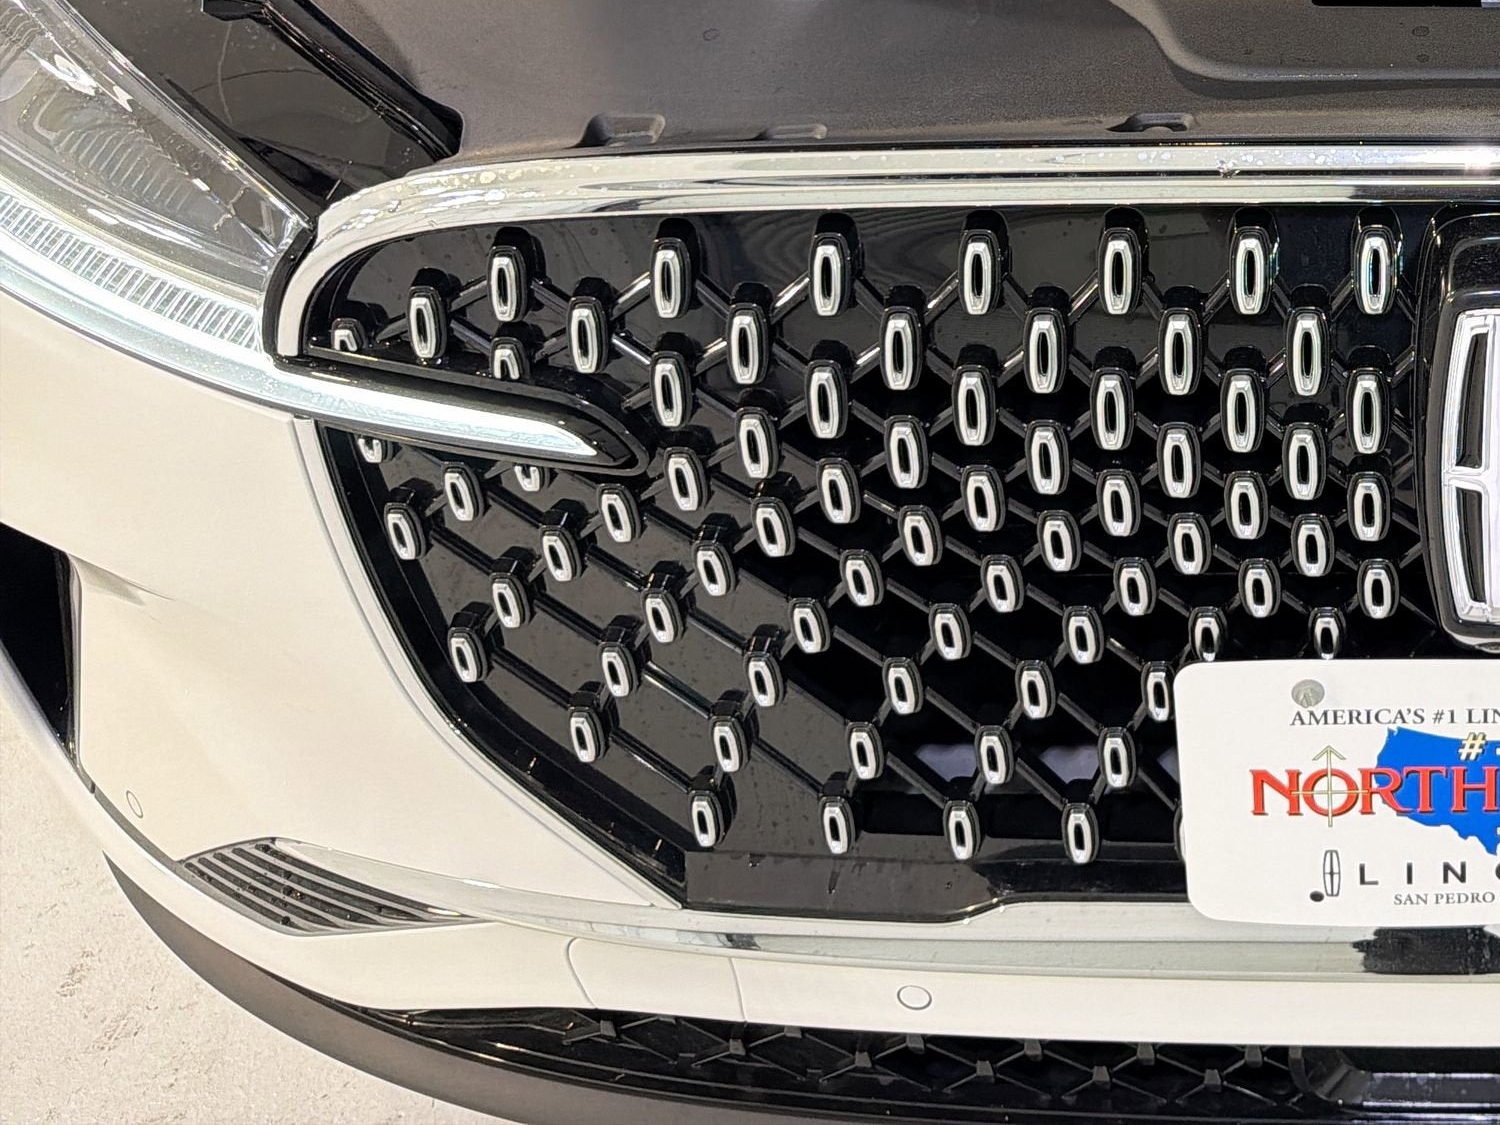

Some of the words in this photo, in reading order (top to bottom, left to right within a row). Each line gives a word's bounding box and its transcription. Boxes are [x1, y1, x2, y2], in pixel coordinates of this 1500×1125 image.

[1290, 708, 1425, 725] AMERICA'S
[1432, 709, 1457, 724] #1
[1250, 766, 1500, 817] NORTH
[1393, 893, 1428, 905] SAN
[1434, 891, 1496, 905] PEDRO
